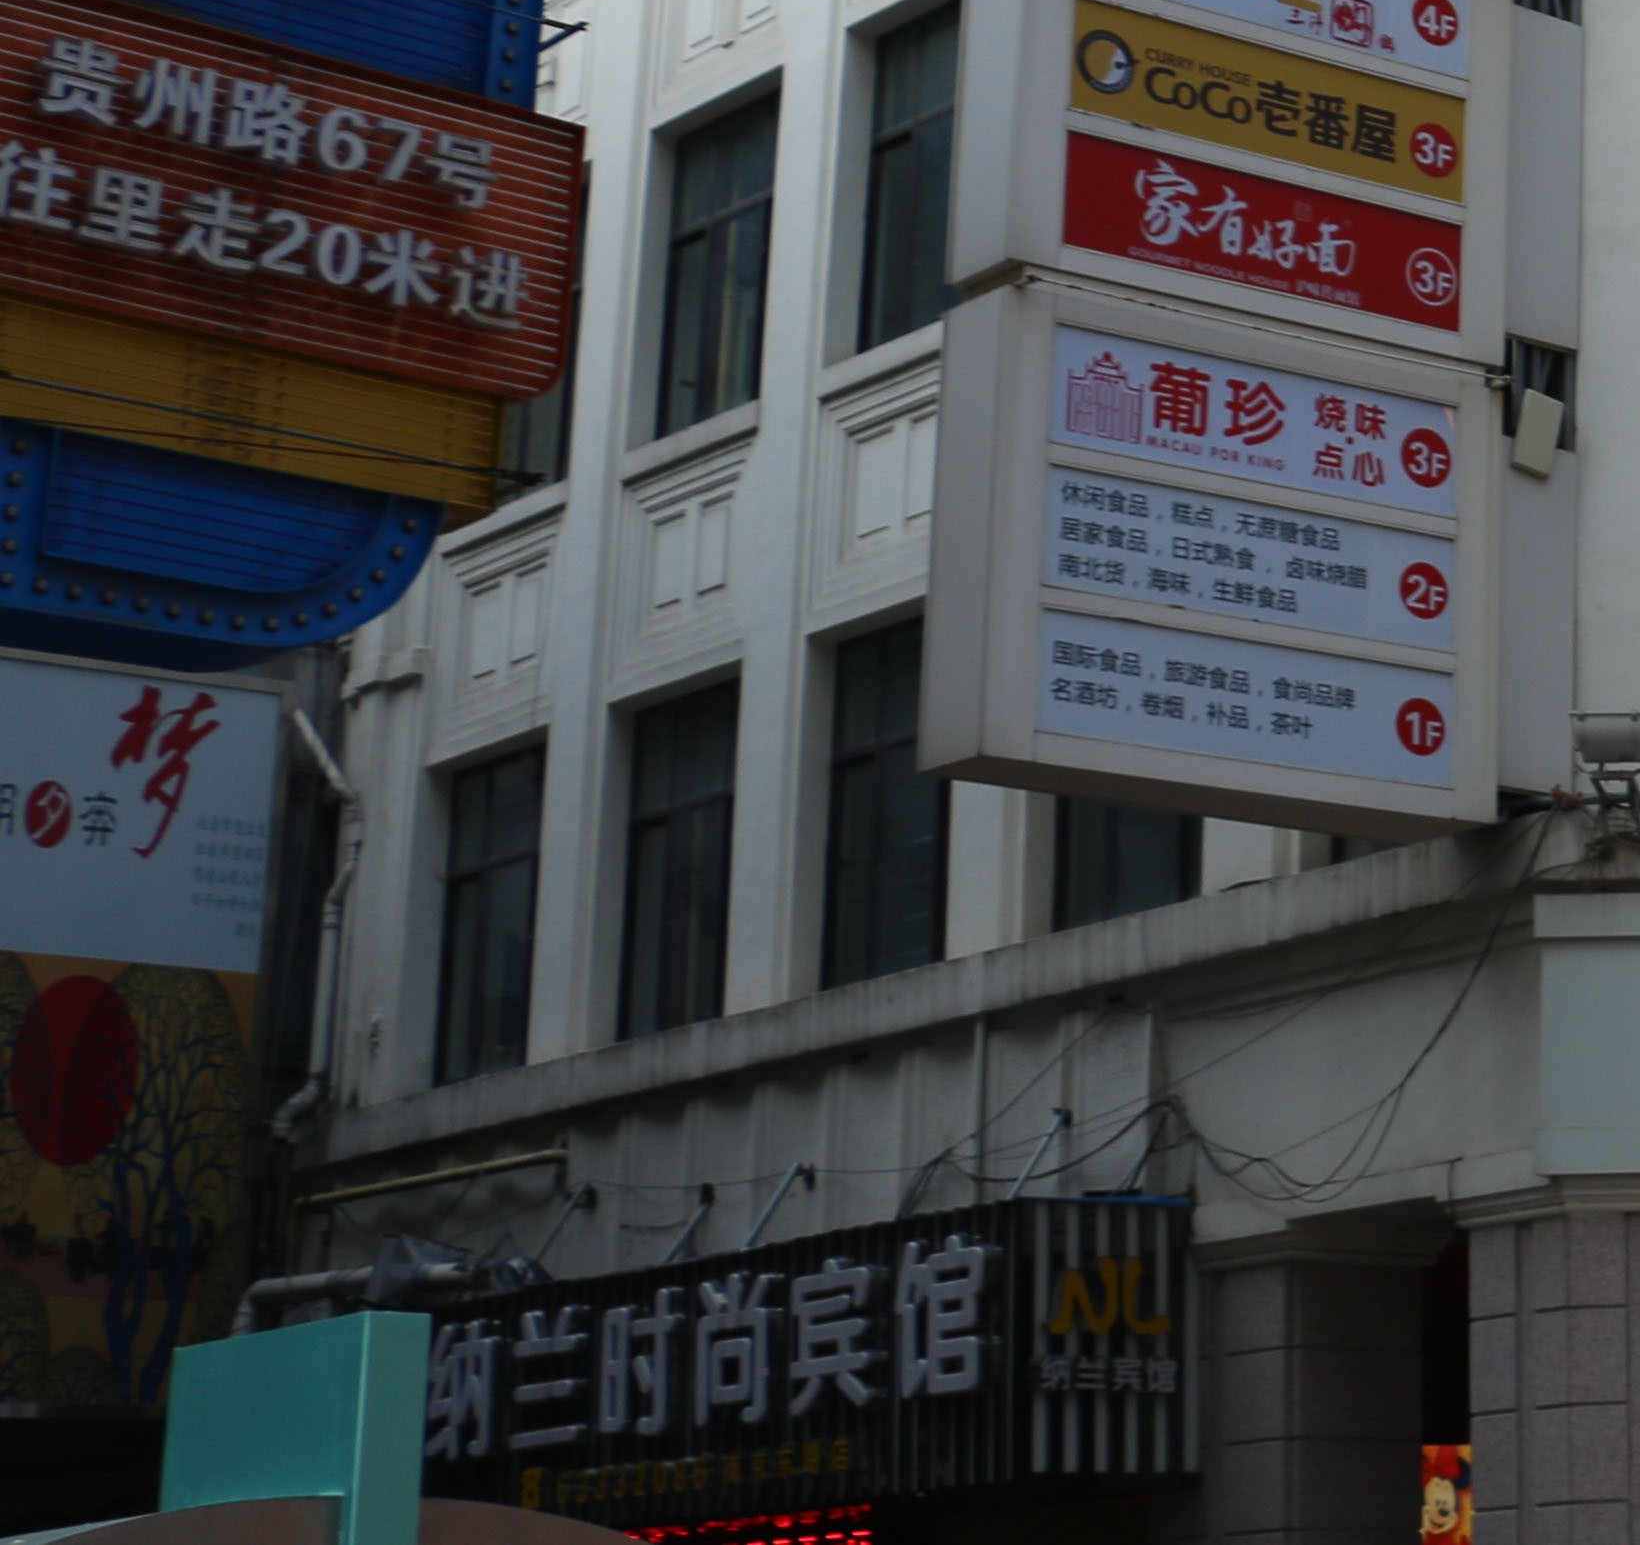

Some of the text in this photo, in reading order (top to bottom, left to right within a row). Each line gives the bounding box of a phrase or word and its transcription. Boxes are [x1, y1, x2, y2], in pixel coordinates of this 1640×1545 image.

[1418, 5, 1456, 39] 4F
[1145, 47, 1253, 87] CURRY HOUSE
[38, 37, 499, 211] 贵州路67号
[1414, 131, 1453, 167] 3F
[0, 139, 531, 331] 往里走20米进
[1134, 159, 1452, 298] 家有好面 3F
[1149, 361, 1287, 446] 葡珍
[1314, 393, 1387, 441] 烧味
[1146, 435, 1202, 457] MACAU
[1247, 452, 1286, 472] KING
[1312, 443, 1386, 487] 点心
[1409, 440, 1447, 477] 3F
[1405, 574, 1445, 611] 2F
[1405, 711, 1441, 746] 1F
[425, 1233, 1000, 1461] 纳兰时尚宾馆
[1039, 1355, 1178, 1395] 纳兰宾馆
